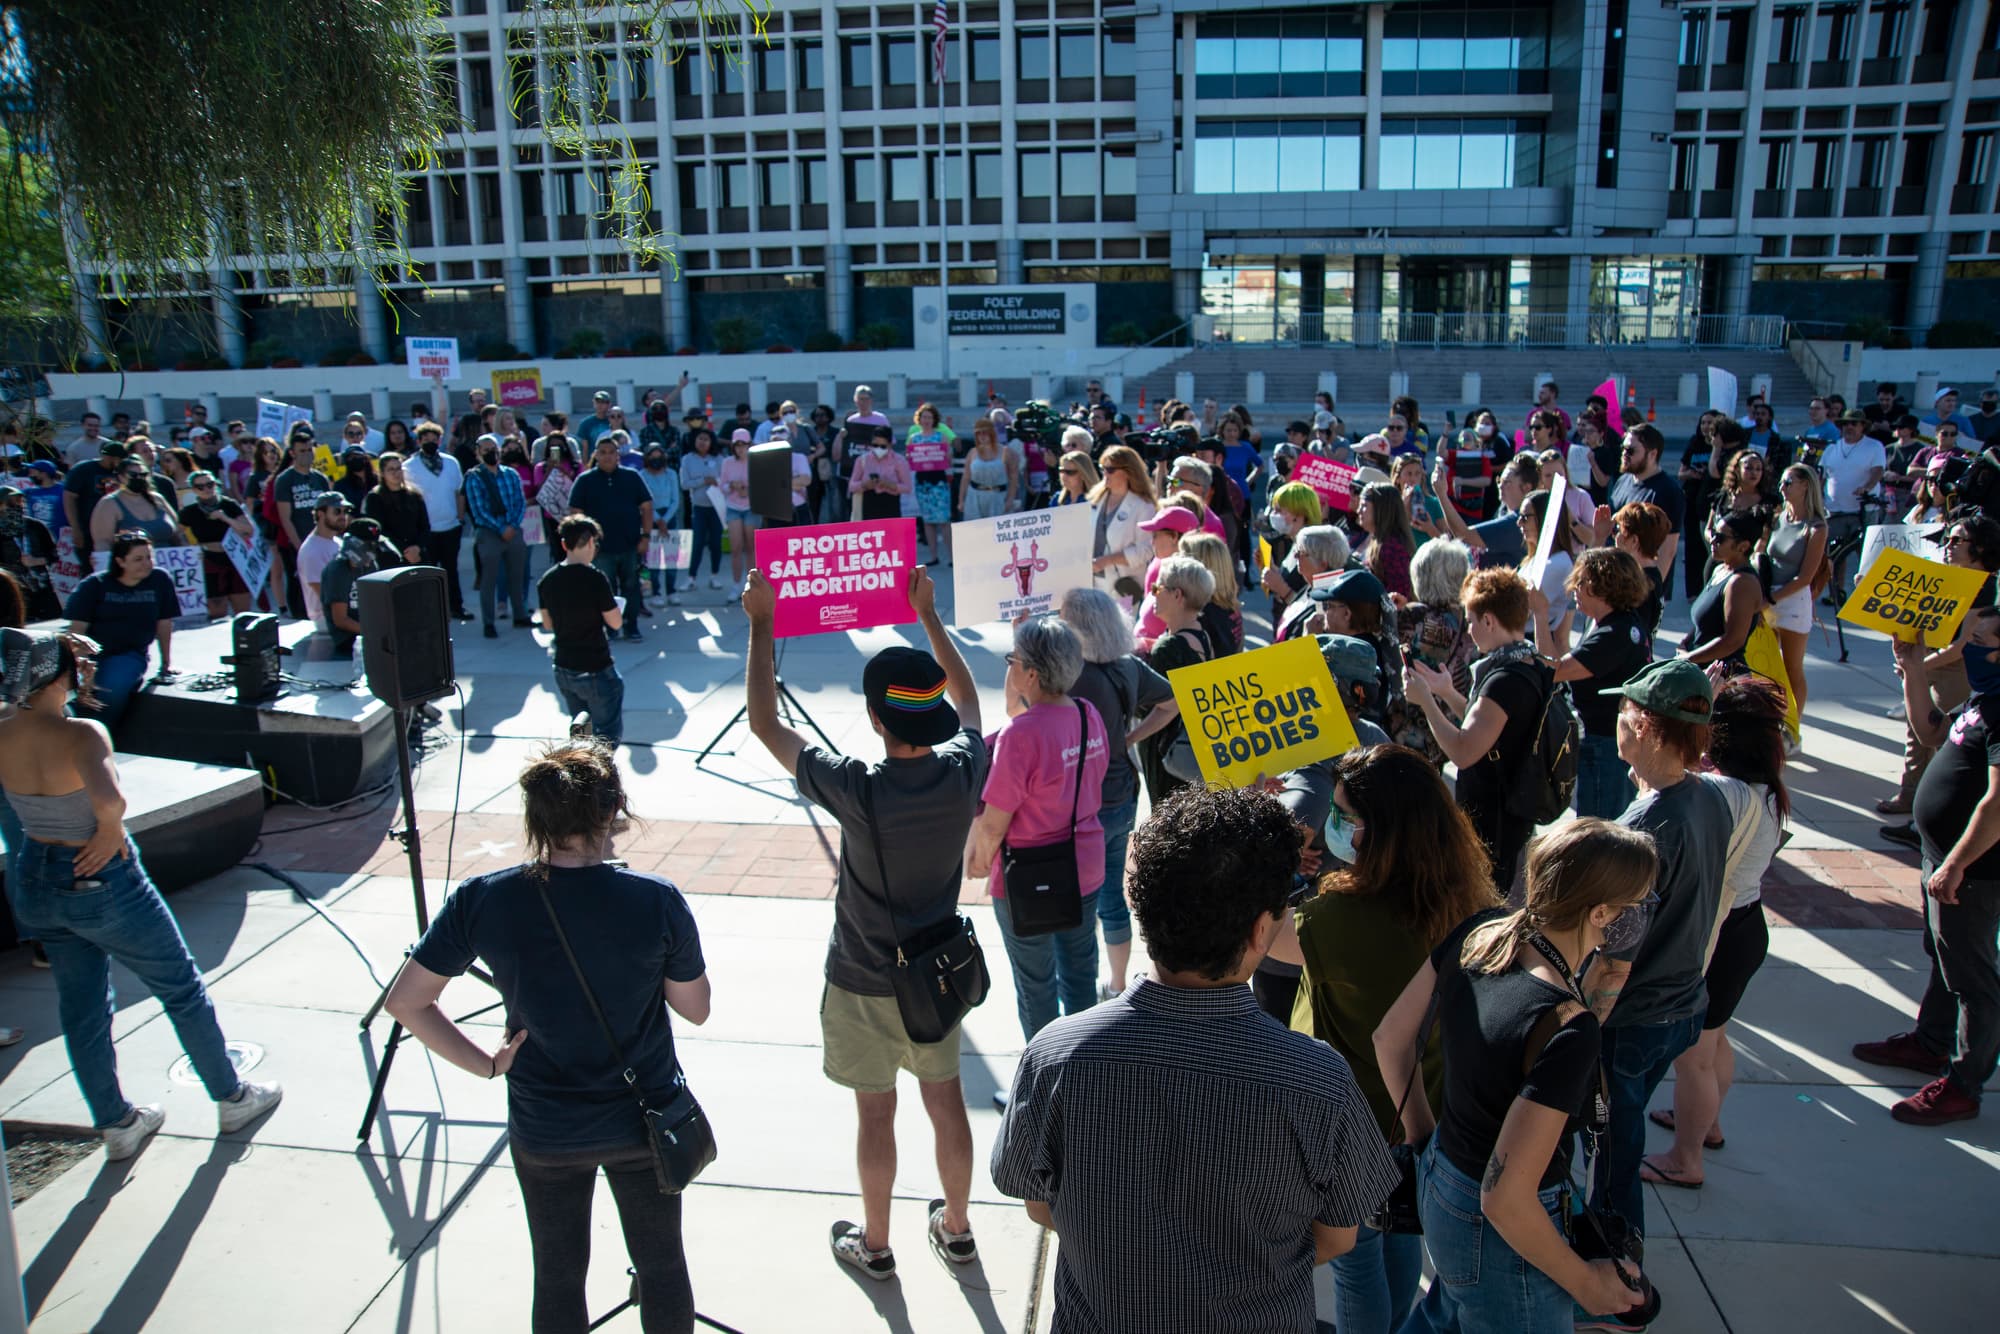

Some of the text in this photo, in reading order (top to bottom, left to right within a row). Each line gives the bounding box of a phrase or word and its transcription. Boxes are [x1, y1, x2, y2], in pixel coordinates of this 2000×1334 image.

[948, 308, 1061, 320] FEDERAL BUILDING
[984, 297, 1023, 308] FOLEY
[412, 339, 452, 349] ABORTION
[419, 356, 449, 365] HUMAN
[996, 513, 1051, 530] WE NEED TO
[996, 526, 1051, 542] TALK ABOUT
[787, 530, 886, 557] PROTECT
[155, 549, 198, 568] ARE
[769, 550, 904, 580] SAFE, LEGAL
[778, 570, 896, 600] ABORTION
[1884, 564, 1945, 595] BANS
[999, 593, 1053, 609] THE ELEPHANT
[1873, 581, 1958, 617] OFF OUR
[1861, 596, 1943, 632] BODIES
[1192, 672, 1263, 713] BANS
[1201, 686, 1322, 740] OFF OUR
[1211, 715, 1320, 769] BODIES
